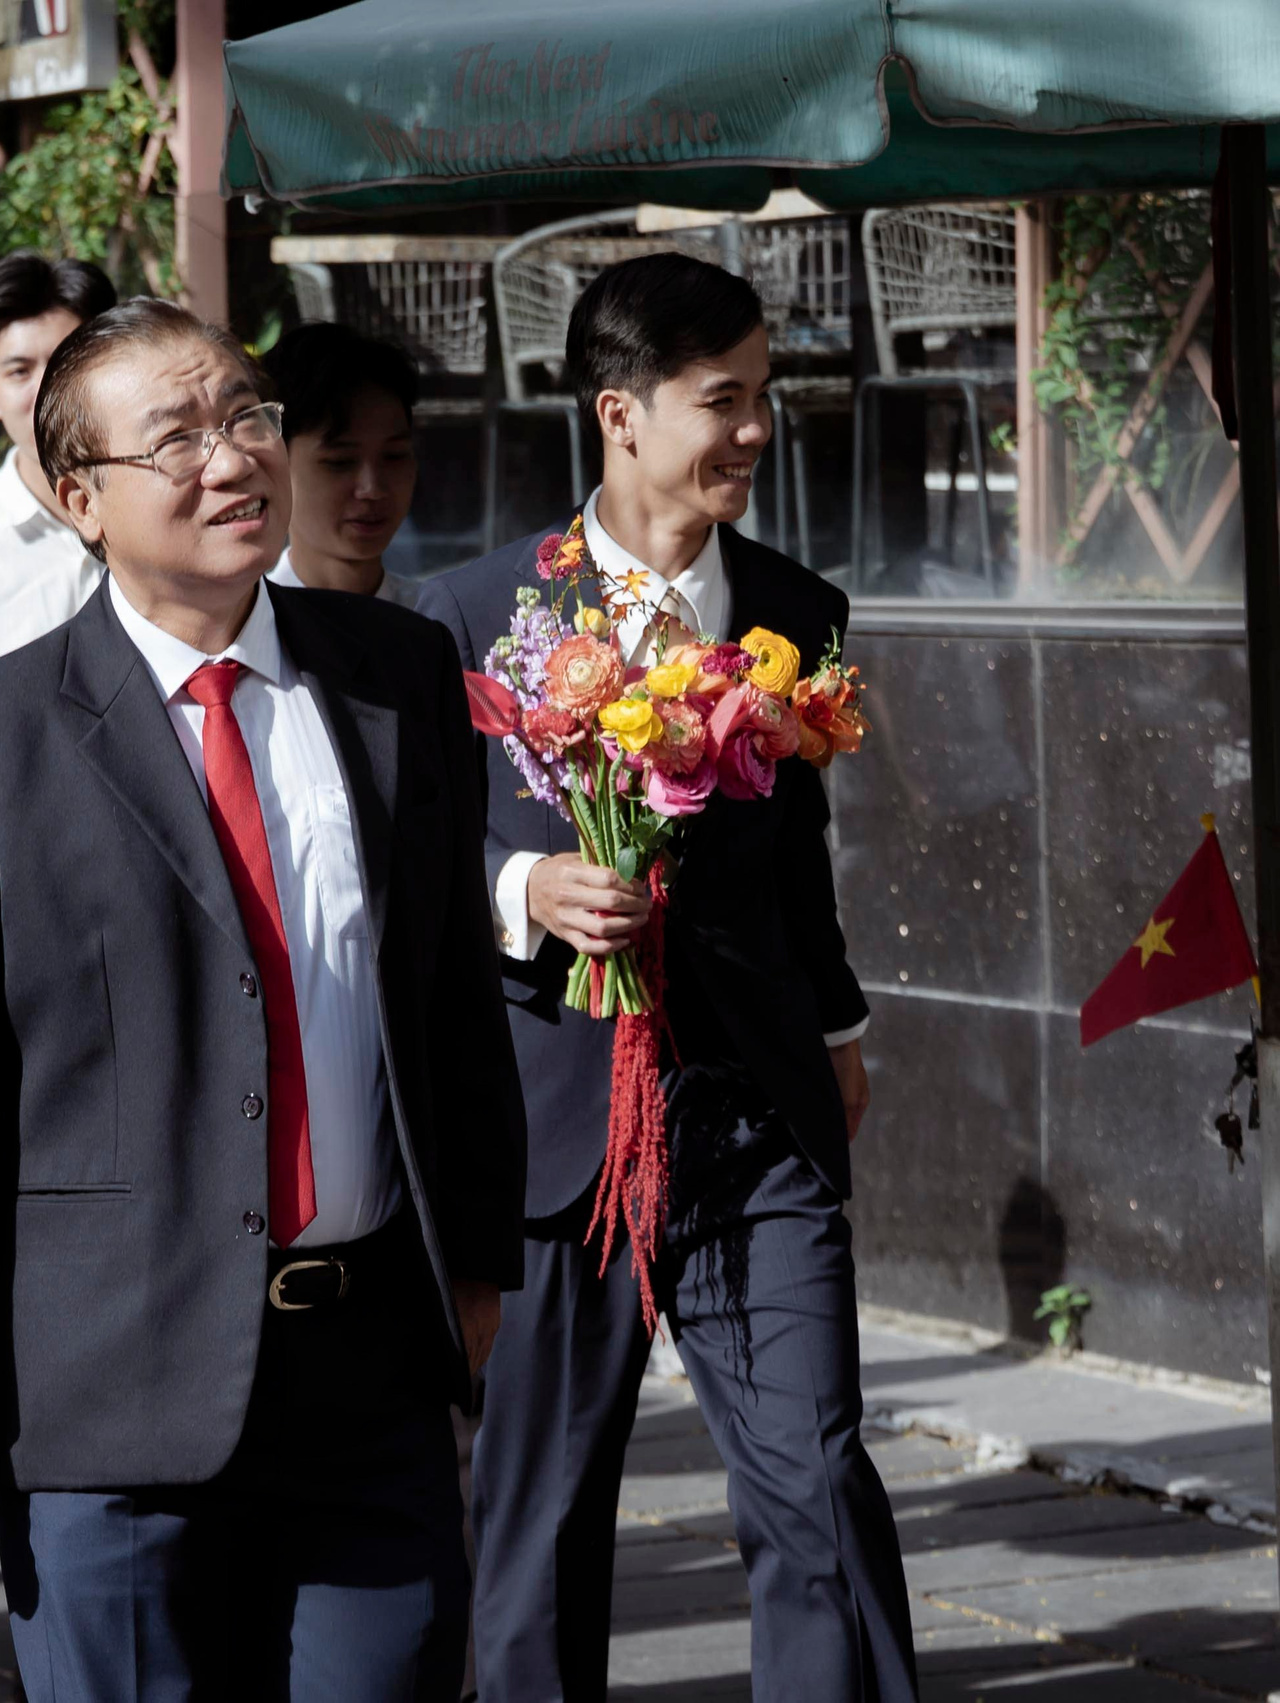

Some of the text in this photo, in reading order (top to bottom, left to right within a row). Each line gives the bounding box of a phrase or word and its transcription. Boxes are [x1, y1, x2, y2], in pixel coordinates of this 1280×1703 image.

[452, 38, 612, 101] The Next
[567, 99, 720, 156] Cuisine
